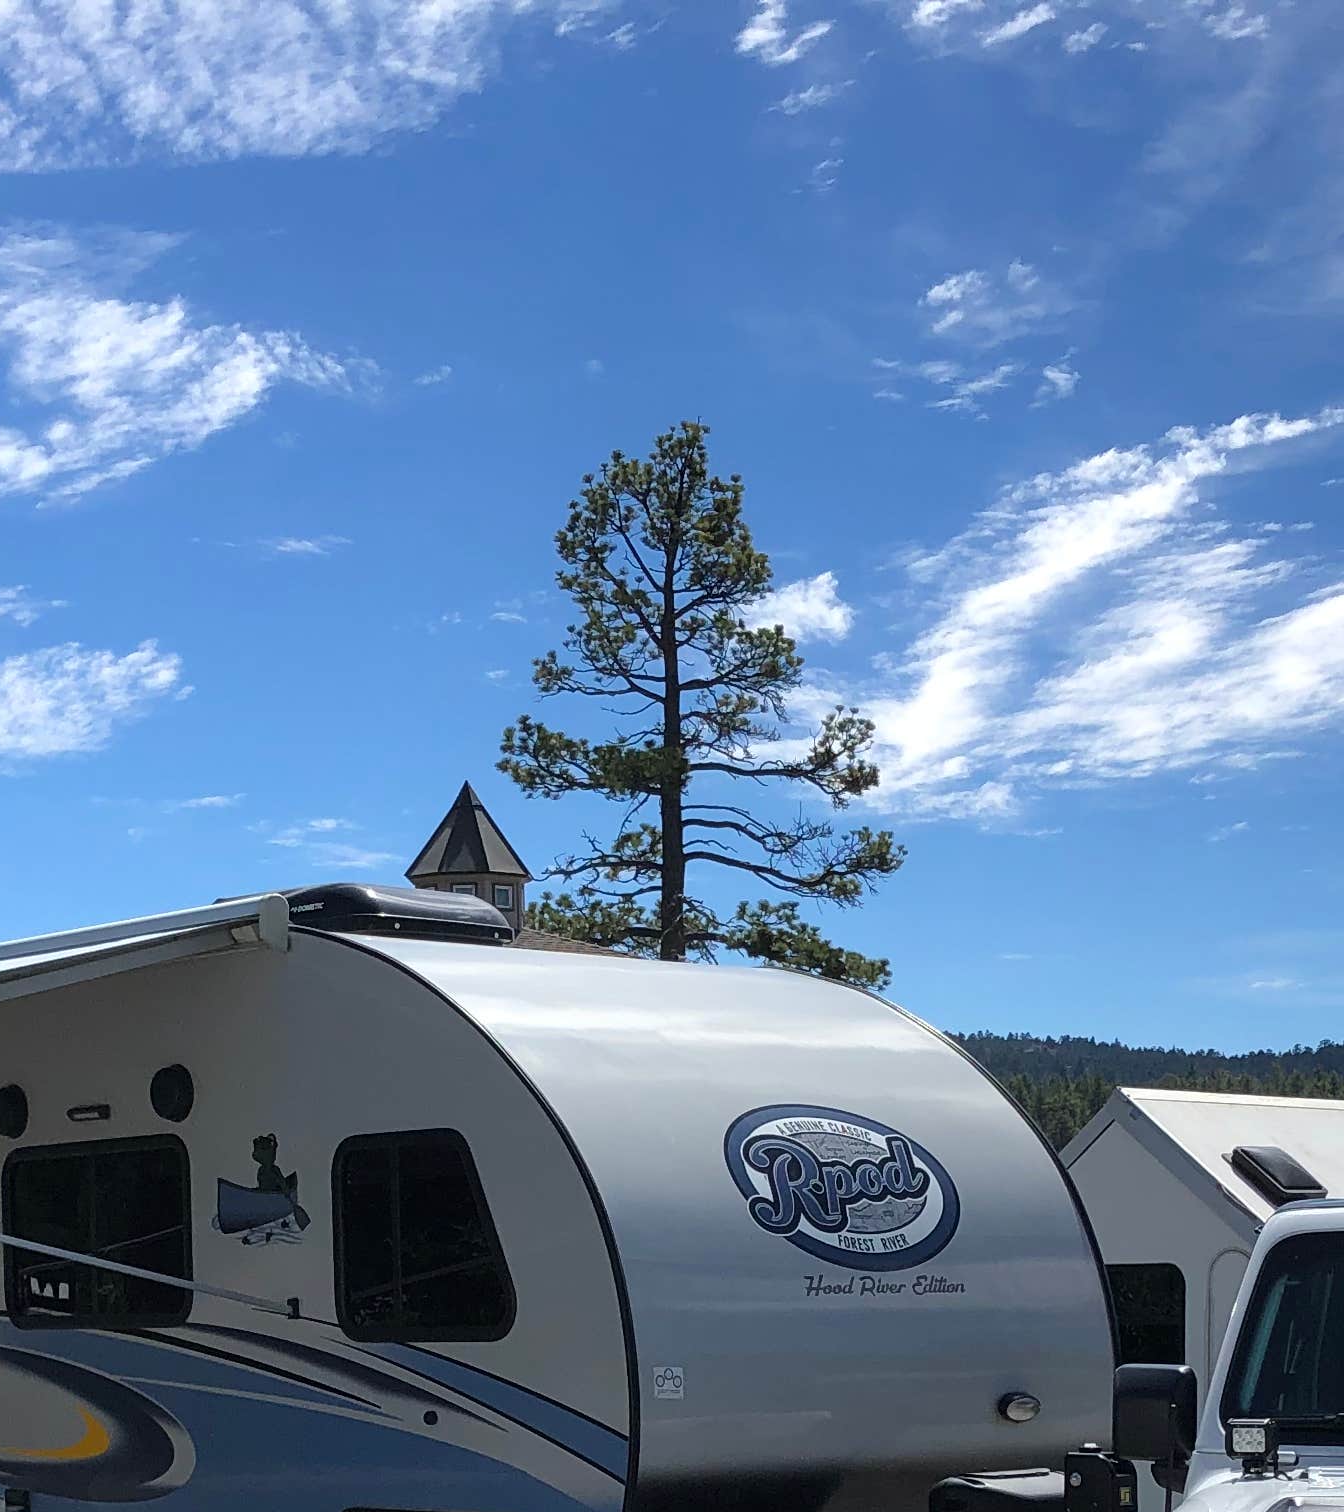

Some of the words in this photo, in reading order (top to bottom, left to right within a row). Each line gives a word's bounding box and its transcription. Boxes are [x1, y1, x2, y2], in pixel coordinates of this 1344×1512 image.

[776, 1124, 787, 1136] A
[783, 1119, 827, 1134] GENUINE
[827, 1121, 872, 1141] CLASSIC
[838, 1234, 875, 1252] FOREST
[881, 1233, 910, 1251] RIVER
[804, 1274, 855, 1297] Hood
[859, 1275, 906, 1297] River
[912, 1274, 966, 1296] Edition
